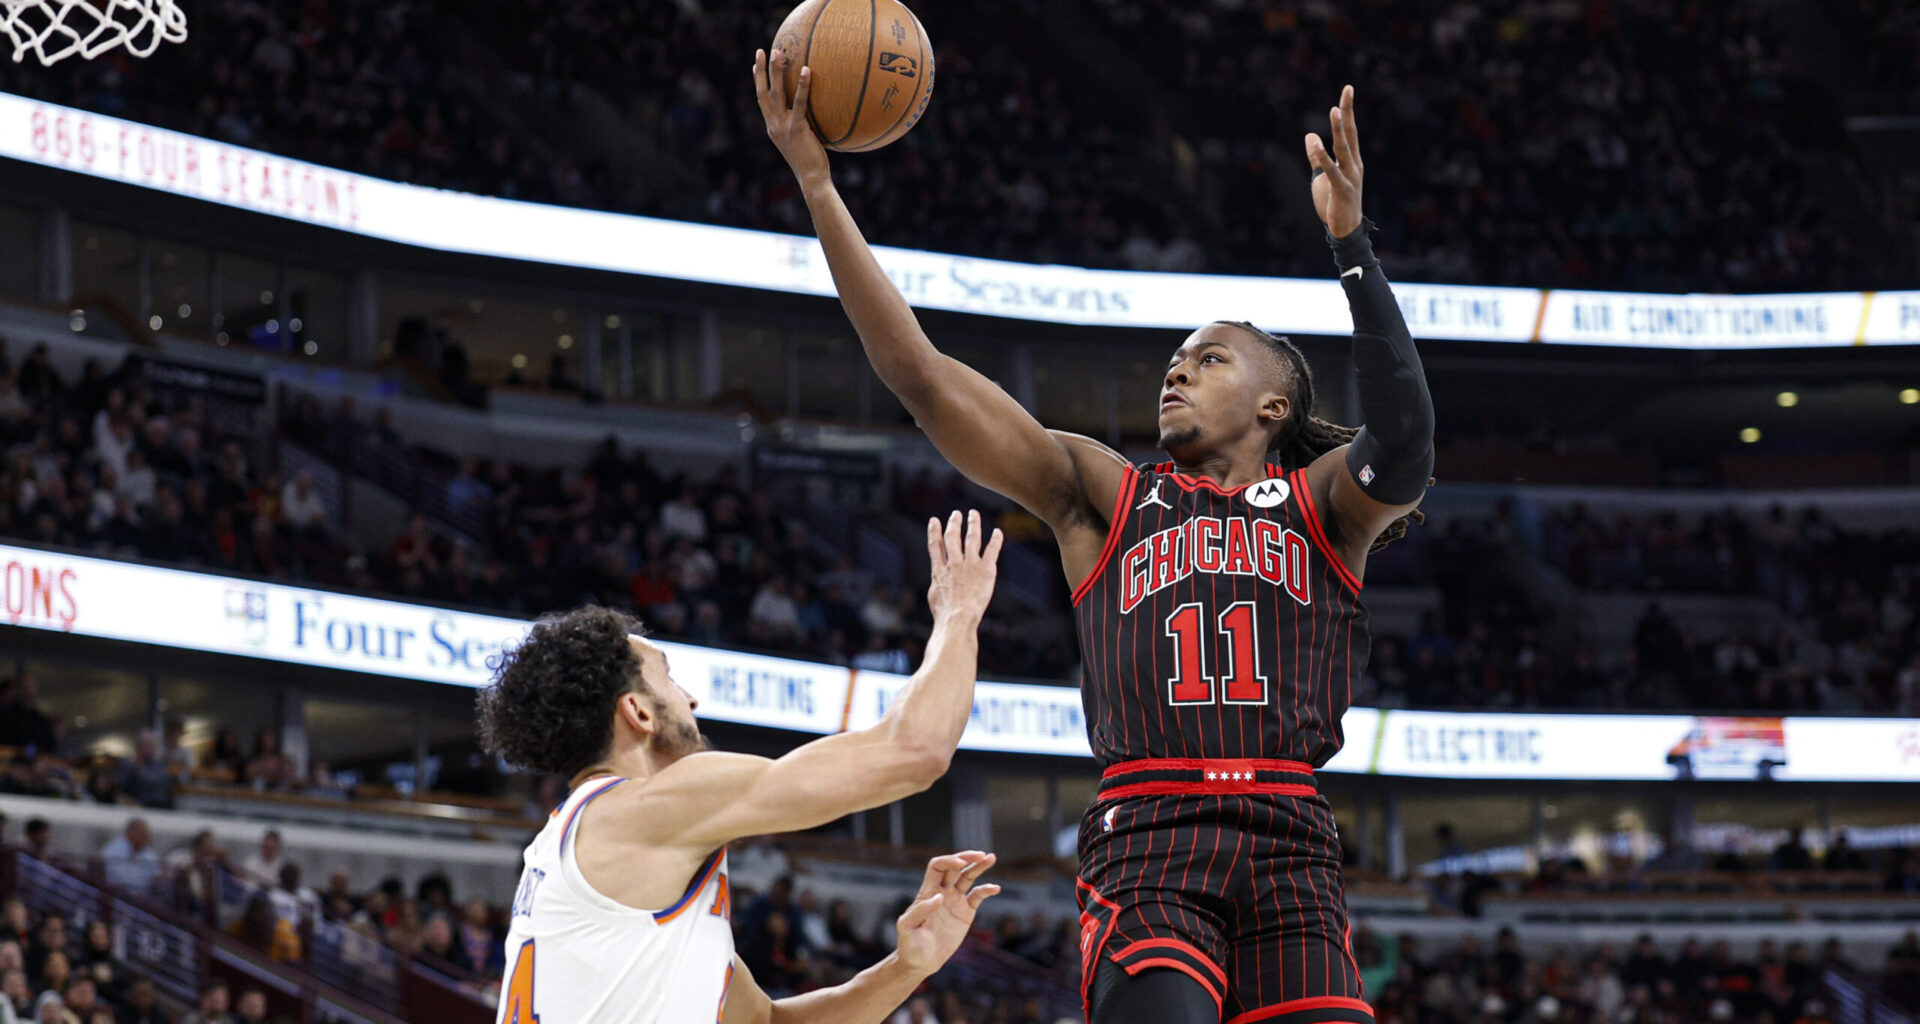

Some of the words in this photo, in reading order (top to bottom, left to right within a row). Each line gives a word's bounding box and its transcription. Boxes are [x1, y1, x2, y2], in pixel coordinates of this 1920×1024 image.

[218, 153, 358, 222] SEASONS
[949, 259, 1131, 312] Seasons
[1400, 296, 1503, 328] EATING
[1573, 304, 1613, 331] AIR
[1627, 305, 1827, 334] CONDITIONING
[1120, 516, 1310, 614] CHICAGO
[293, 599, 415, 660] Four
[1166, 601, 1268, 706] 11
[709, 664, 815, 717] HEATING
[1406, 725, 1542, 763] ELECTRIC
